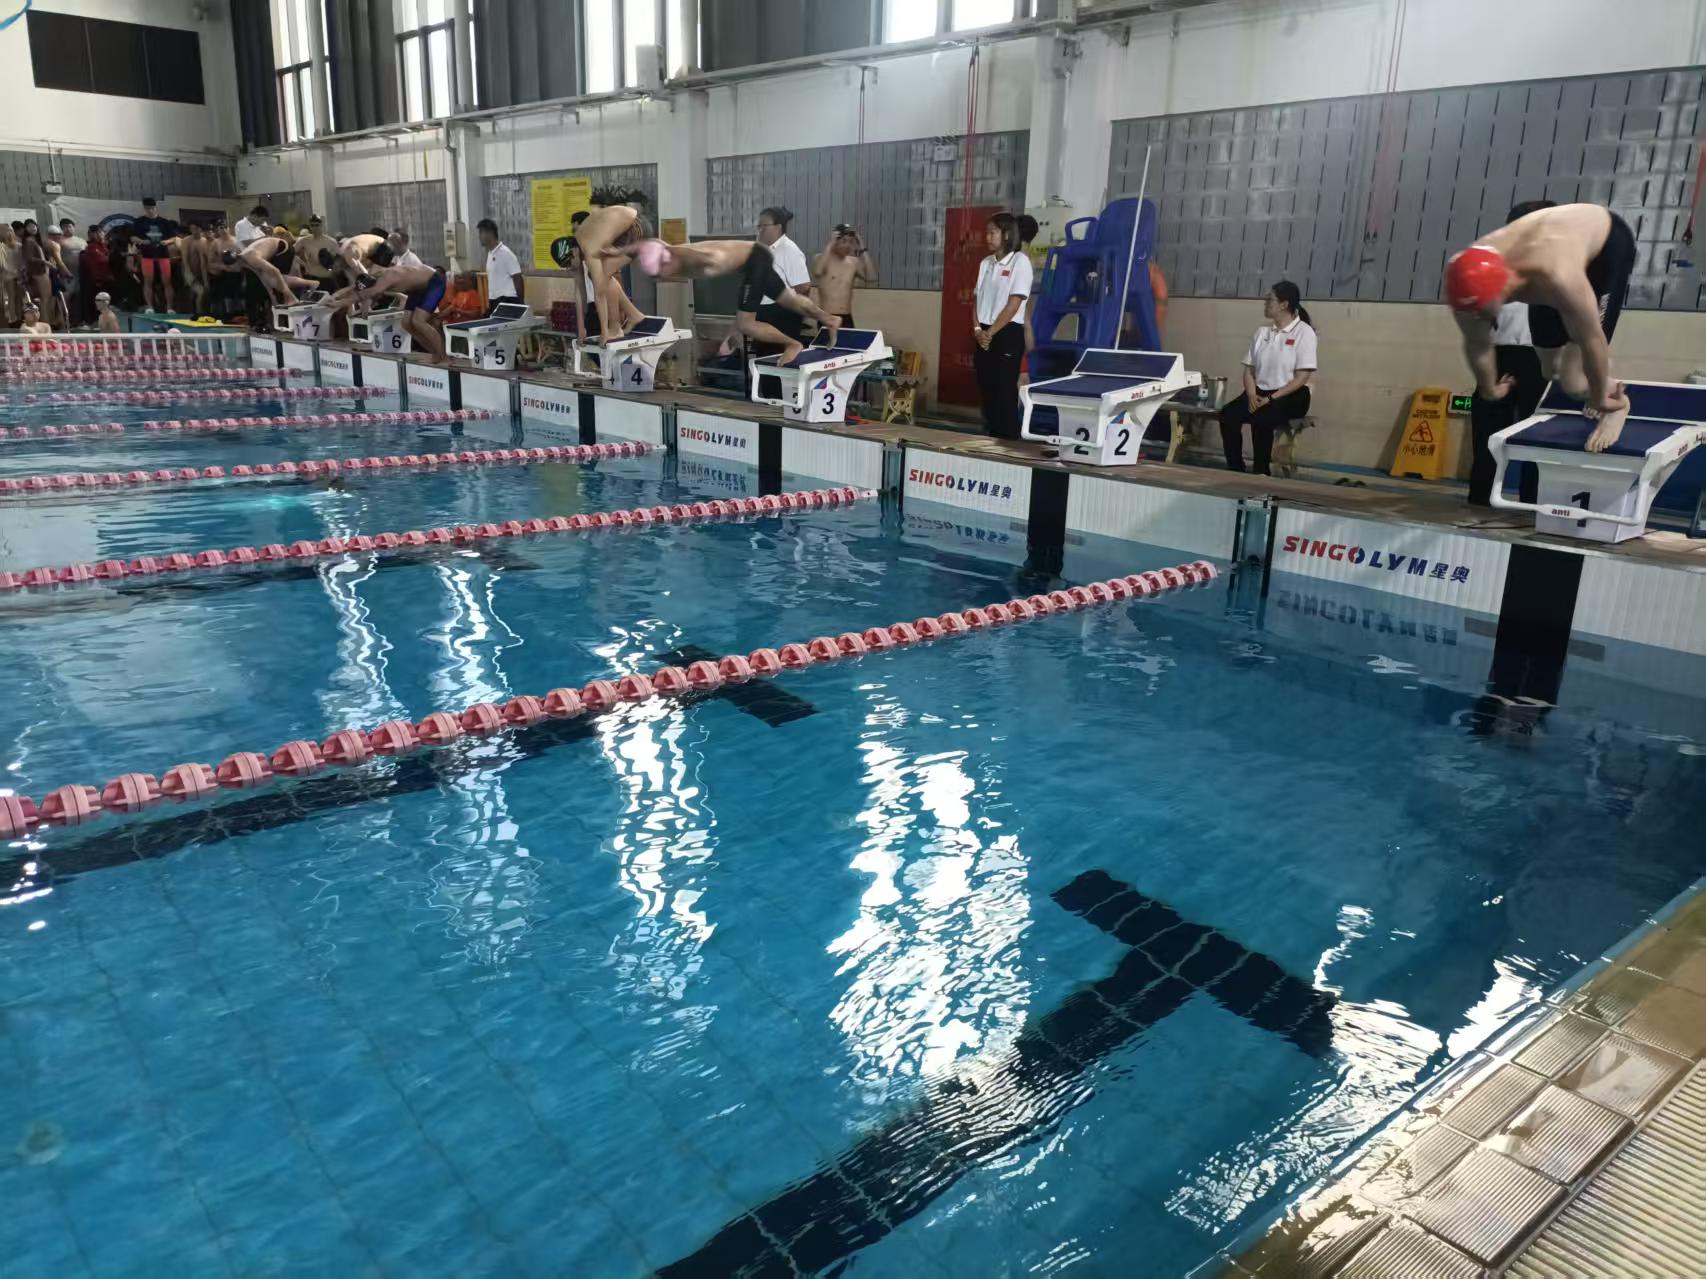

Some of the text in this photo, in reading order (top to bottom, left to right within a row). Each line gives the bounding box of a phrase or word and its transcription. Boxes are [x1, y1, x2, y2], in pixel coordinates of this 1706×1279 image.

[312, 324, 320, 336] 7
[392, 335, 402, 348] 6
[495, 349, 505, 365] 5
[631, 368, 643, 385] 4
[822, 393, 834, 414] 3
[1074, 427, 1090, 456] 2
[1114, 428, 1130, 456] 2
[1551, 508, 1570, 517] anti
[1571, 491, 1590, 528] 1
[1282, 535, 1427, 577] SINGOLYM
